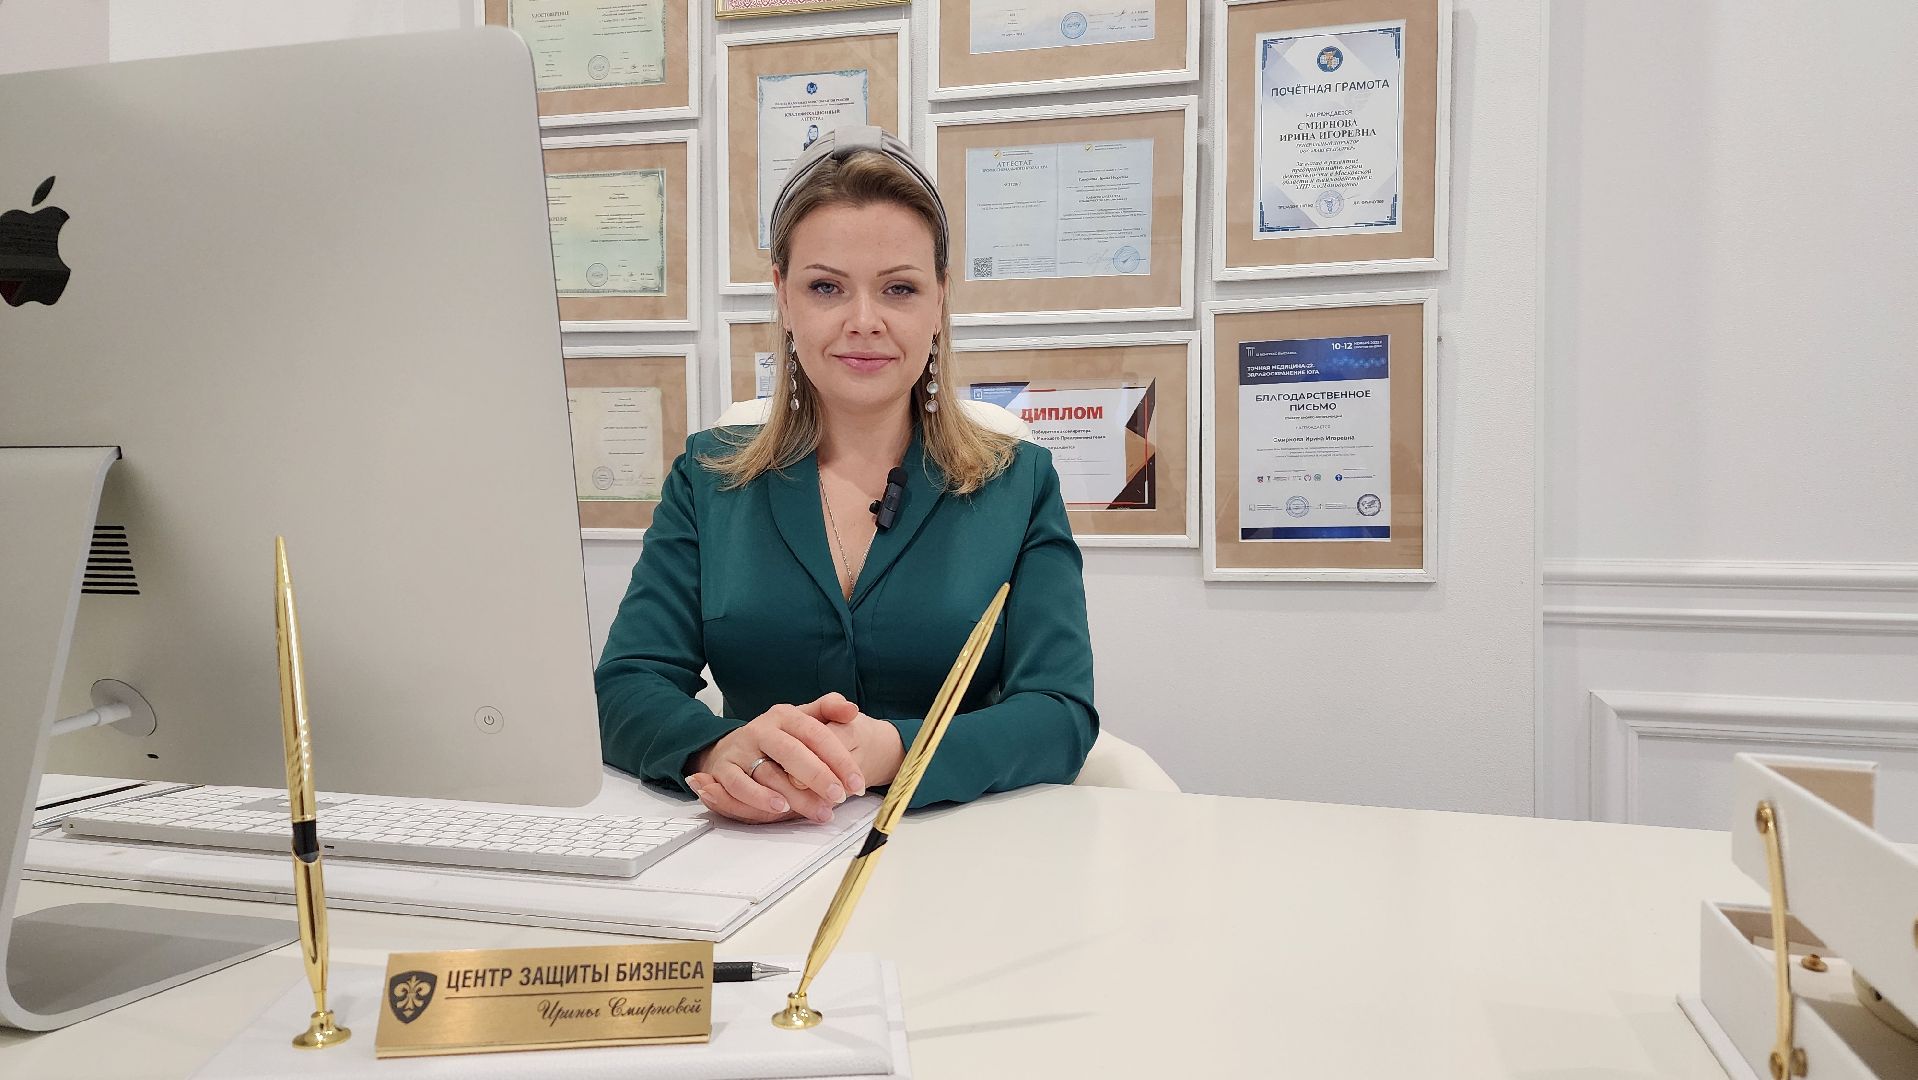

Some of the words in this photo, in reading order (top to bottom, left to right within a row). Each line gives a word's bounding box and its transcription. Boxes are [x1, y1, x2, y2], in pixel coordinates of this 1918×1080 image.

[1271, 83, 1331, 97] ПОЧЁТНАЯ
[1335, 79, 1390, 92] ГРАМОТА
[1297, 119, 1358, 130] СМИРНОВА
[1280, 131, 1316, 141] ИРИНА
[1319, 128, 1376, 140] ИГОРЕВНА
[1256, 390, 1371, 402] БЛАГОДАРСТВЕННОЕ
[1021, 406, 1103, 423] ДИПЛОМ
[1290, 402, 1337, 412] ПИСЬМО
[447, 968, 512, 992] ЦЕНТР
[519, 963, 609, 987] ЗАЩИТЫ
[616, 960, 705, 982] БИЗНЕСА
[537, 999, 601, 1027] Ирины
[608, 996, 702, 1024] Смирновой
